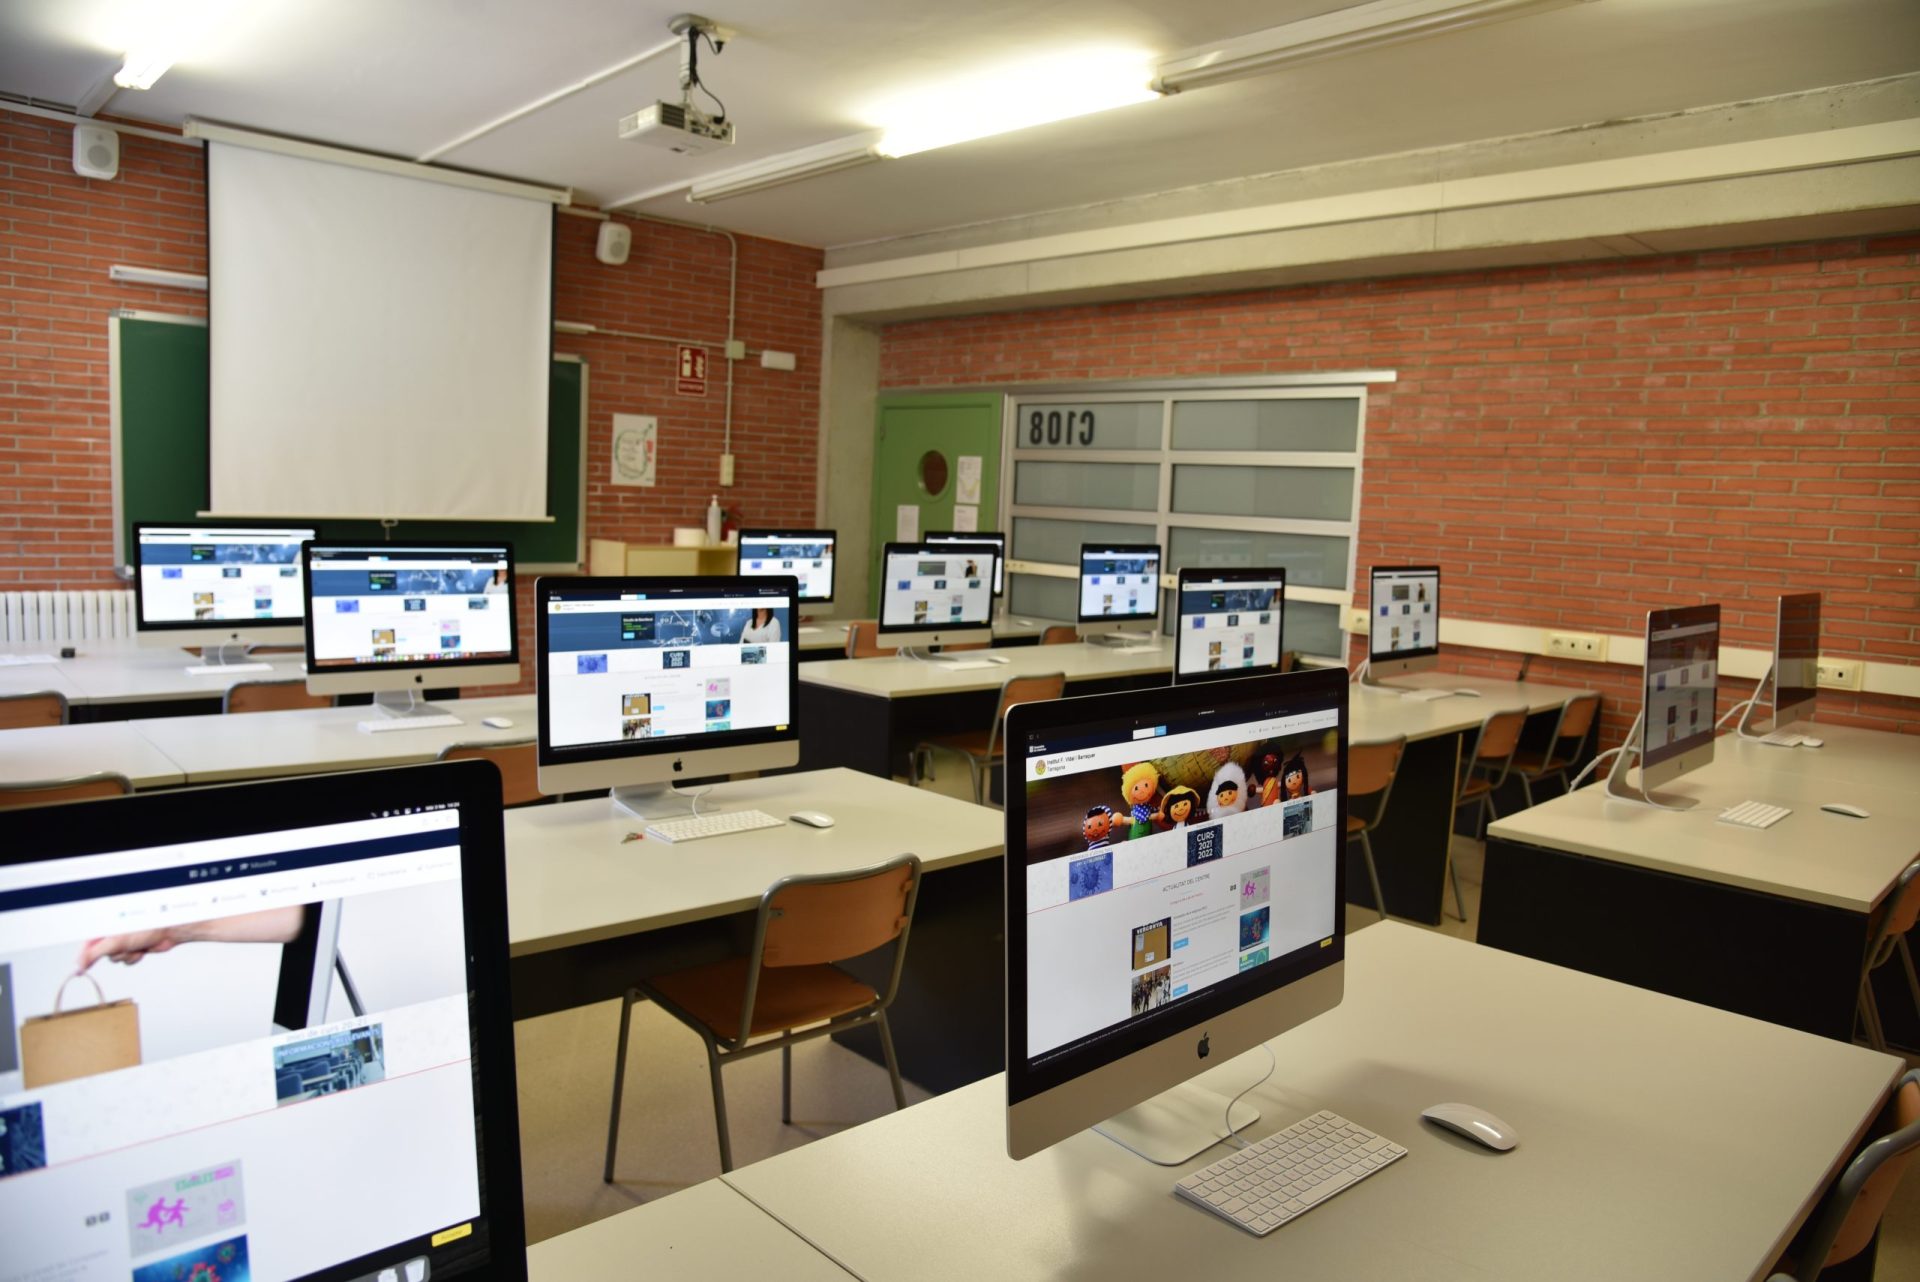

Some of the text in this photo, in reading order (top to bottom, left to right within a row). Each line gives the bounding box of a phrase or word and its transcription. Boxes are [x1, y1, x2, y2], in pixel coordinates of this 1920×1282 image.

[1196, 830, 1215, 842] CURS
[1198, 840, 1213, 851] 2021
[1198, 849, 1213, 860] 2022
